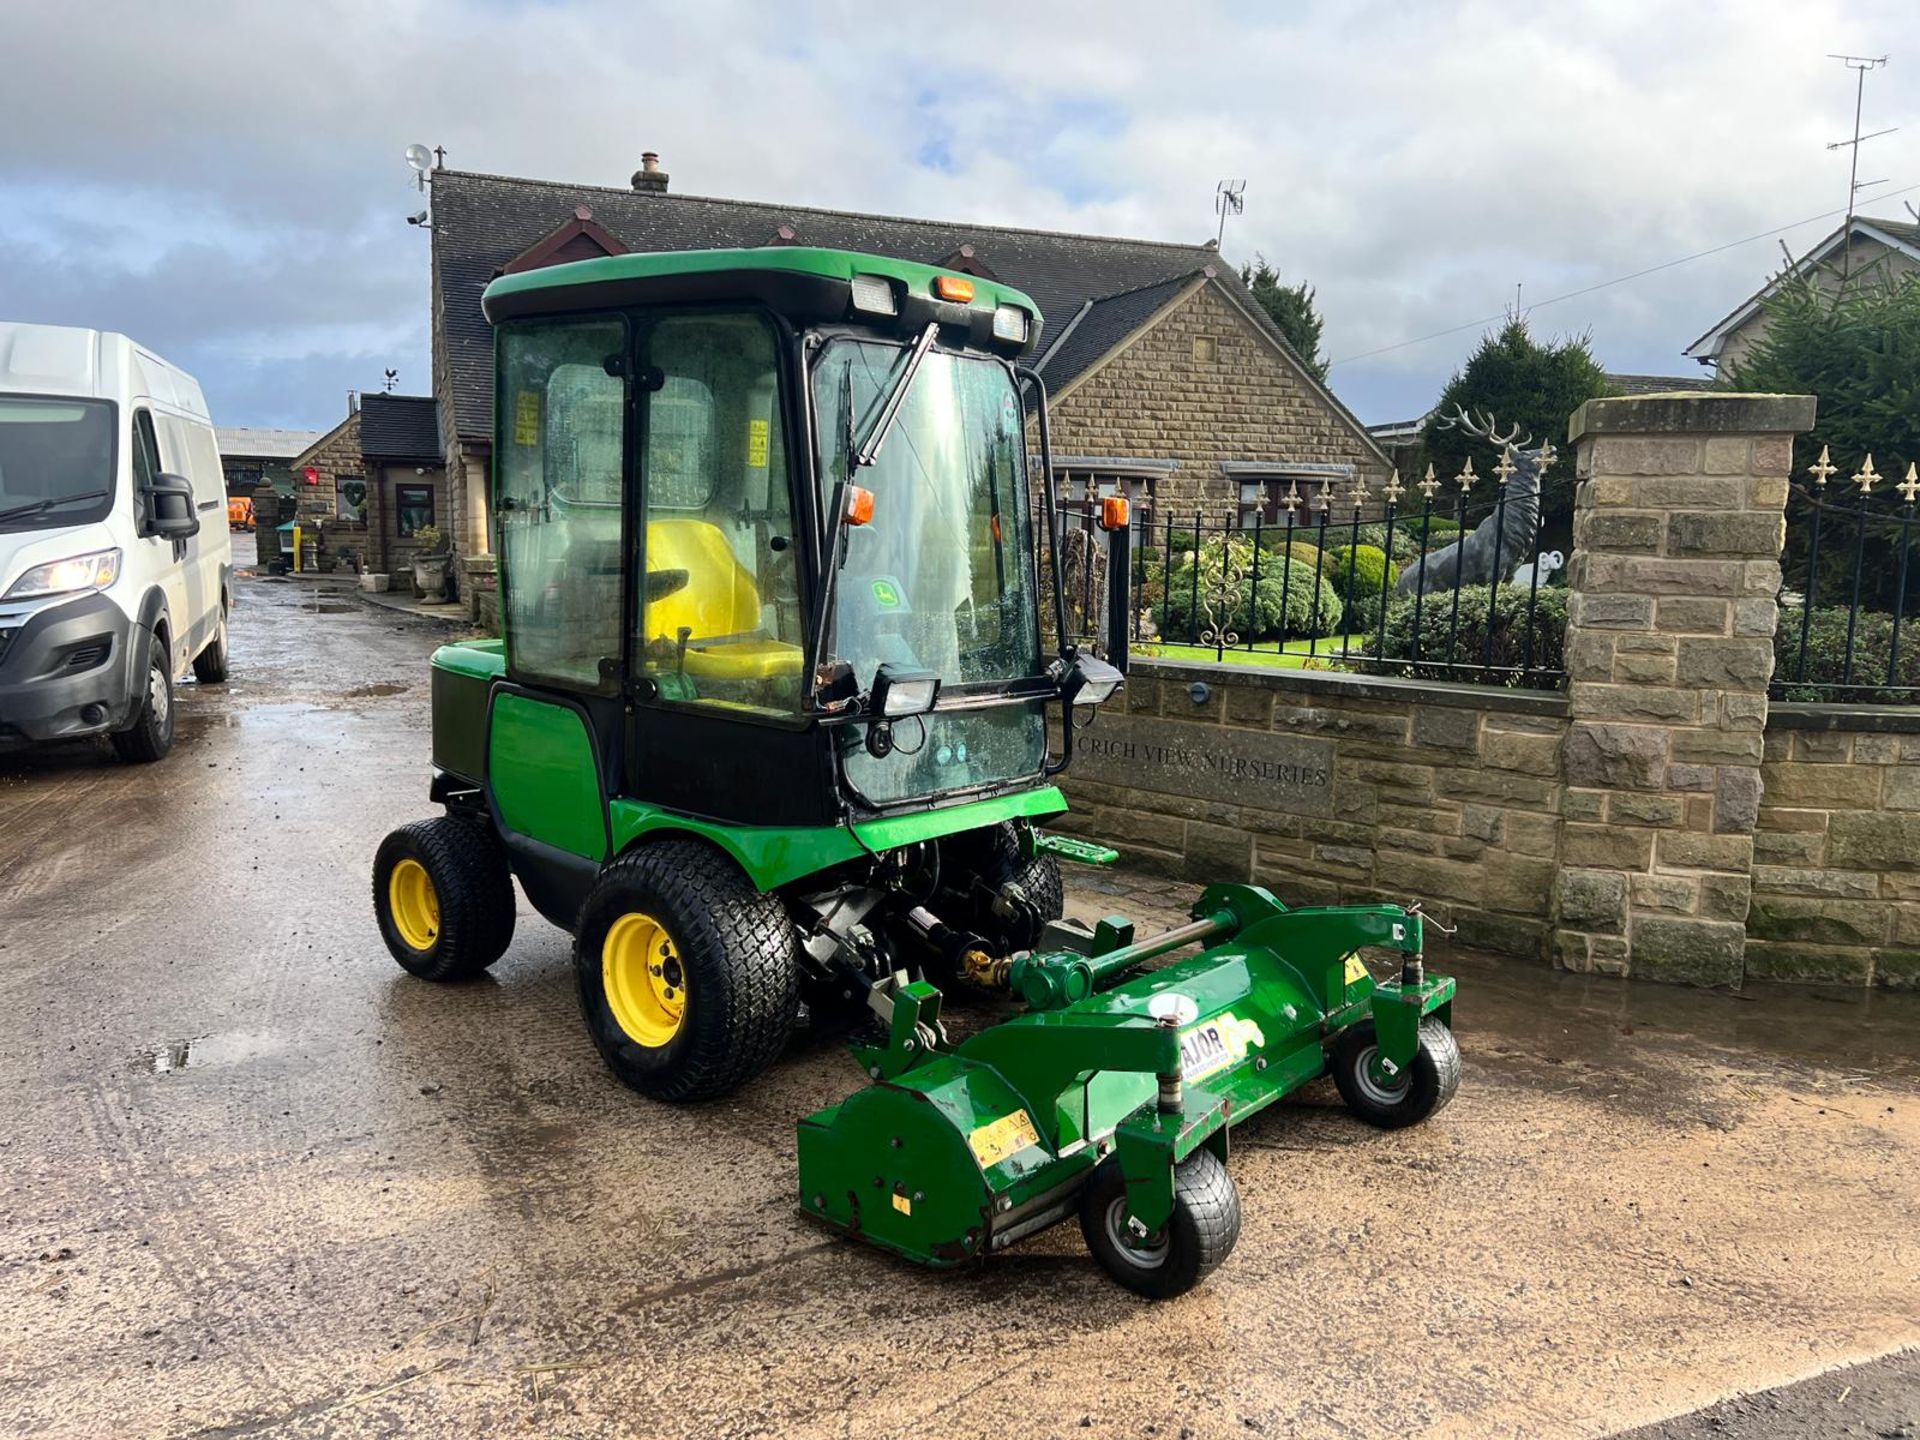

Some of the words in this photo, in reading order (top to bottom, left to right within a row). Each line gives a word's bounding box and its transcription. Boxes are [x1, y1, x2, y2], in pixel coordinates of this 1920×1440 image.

[1077, 735, 1136, 760] CRICH
[1143, 744, 1196, 767] VIEW
[1202, 752, 1328, 788] NURSERIES
[1180, 1027, 1225, 1069] AJOR
